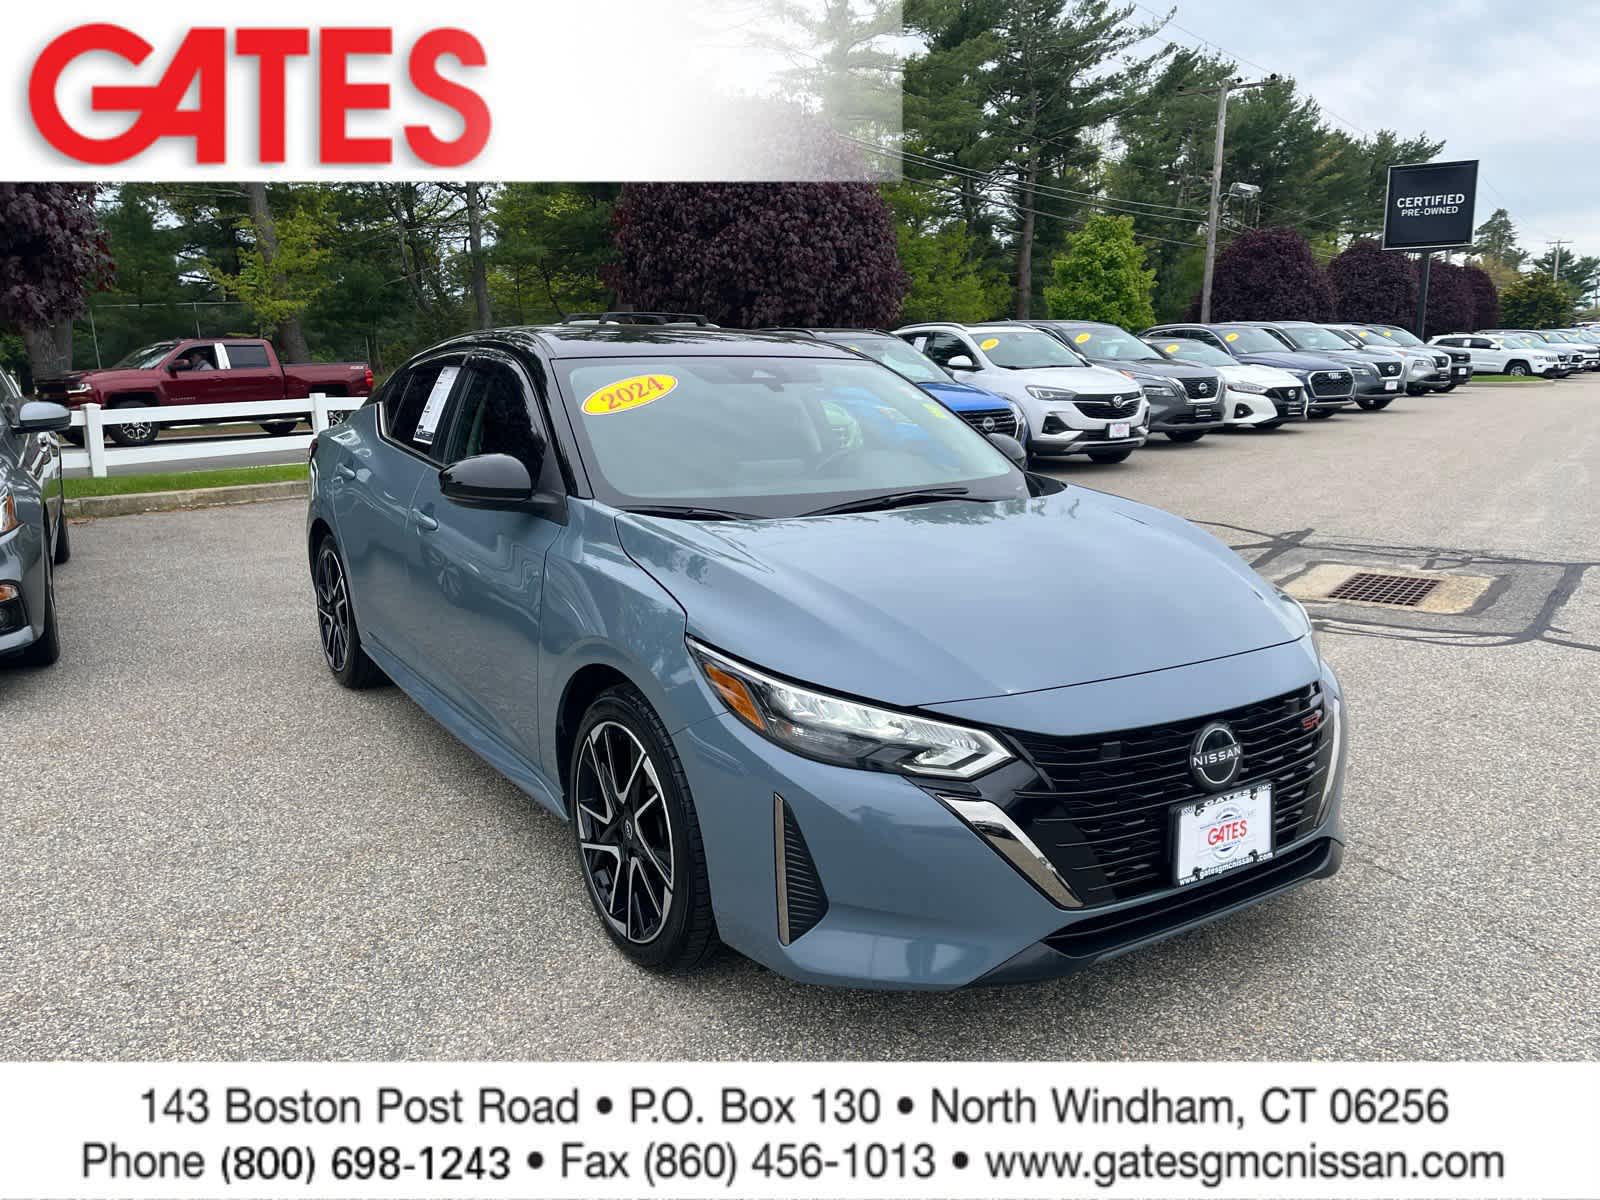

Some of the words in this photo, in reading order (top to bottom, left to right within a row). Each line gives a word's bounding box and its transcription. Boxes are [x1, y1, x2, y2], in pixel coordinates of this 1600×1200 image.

[1396, 193, 1465, 208] CERTIFIED
[1401, 206, 1458, 217] PRE-OWNED
[600, 376, 664, 410] 2024
[1193, 744, 1241, 767] NISSAN
[1208, 820, 1248, 845] GATES
